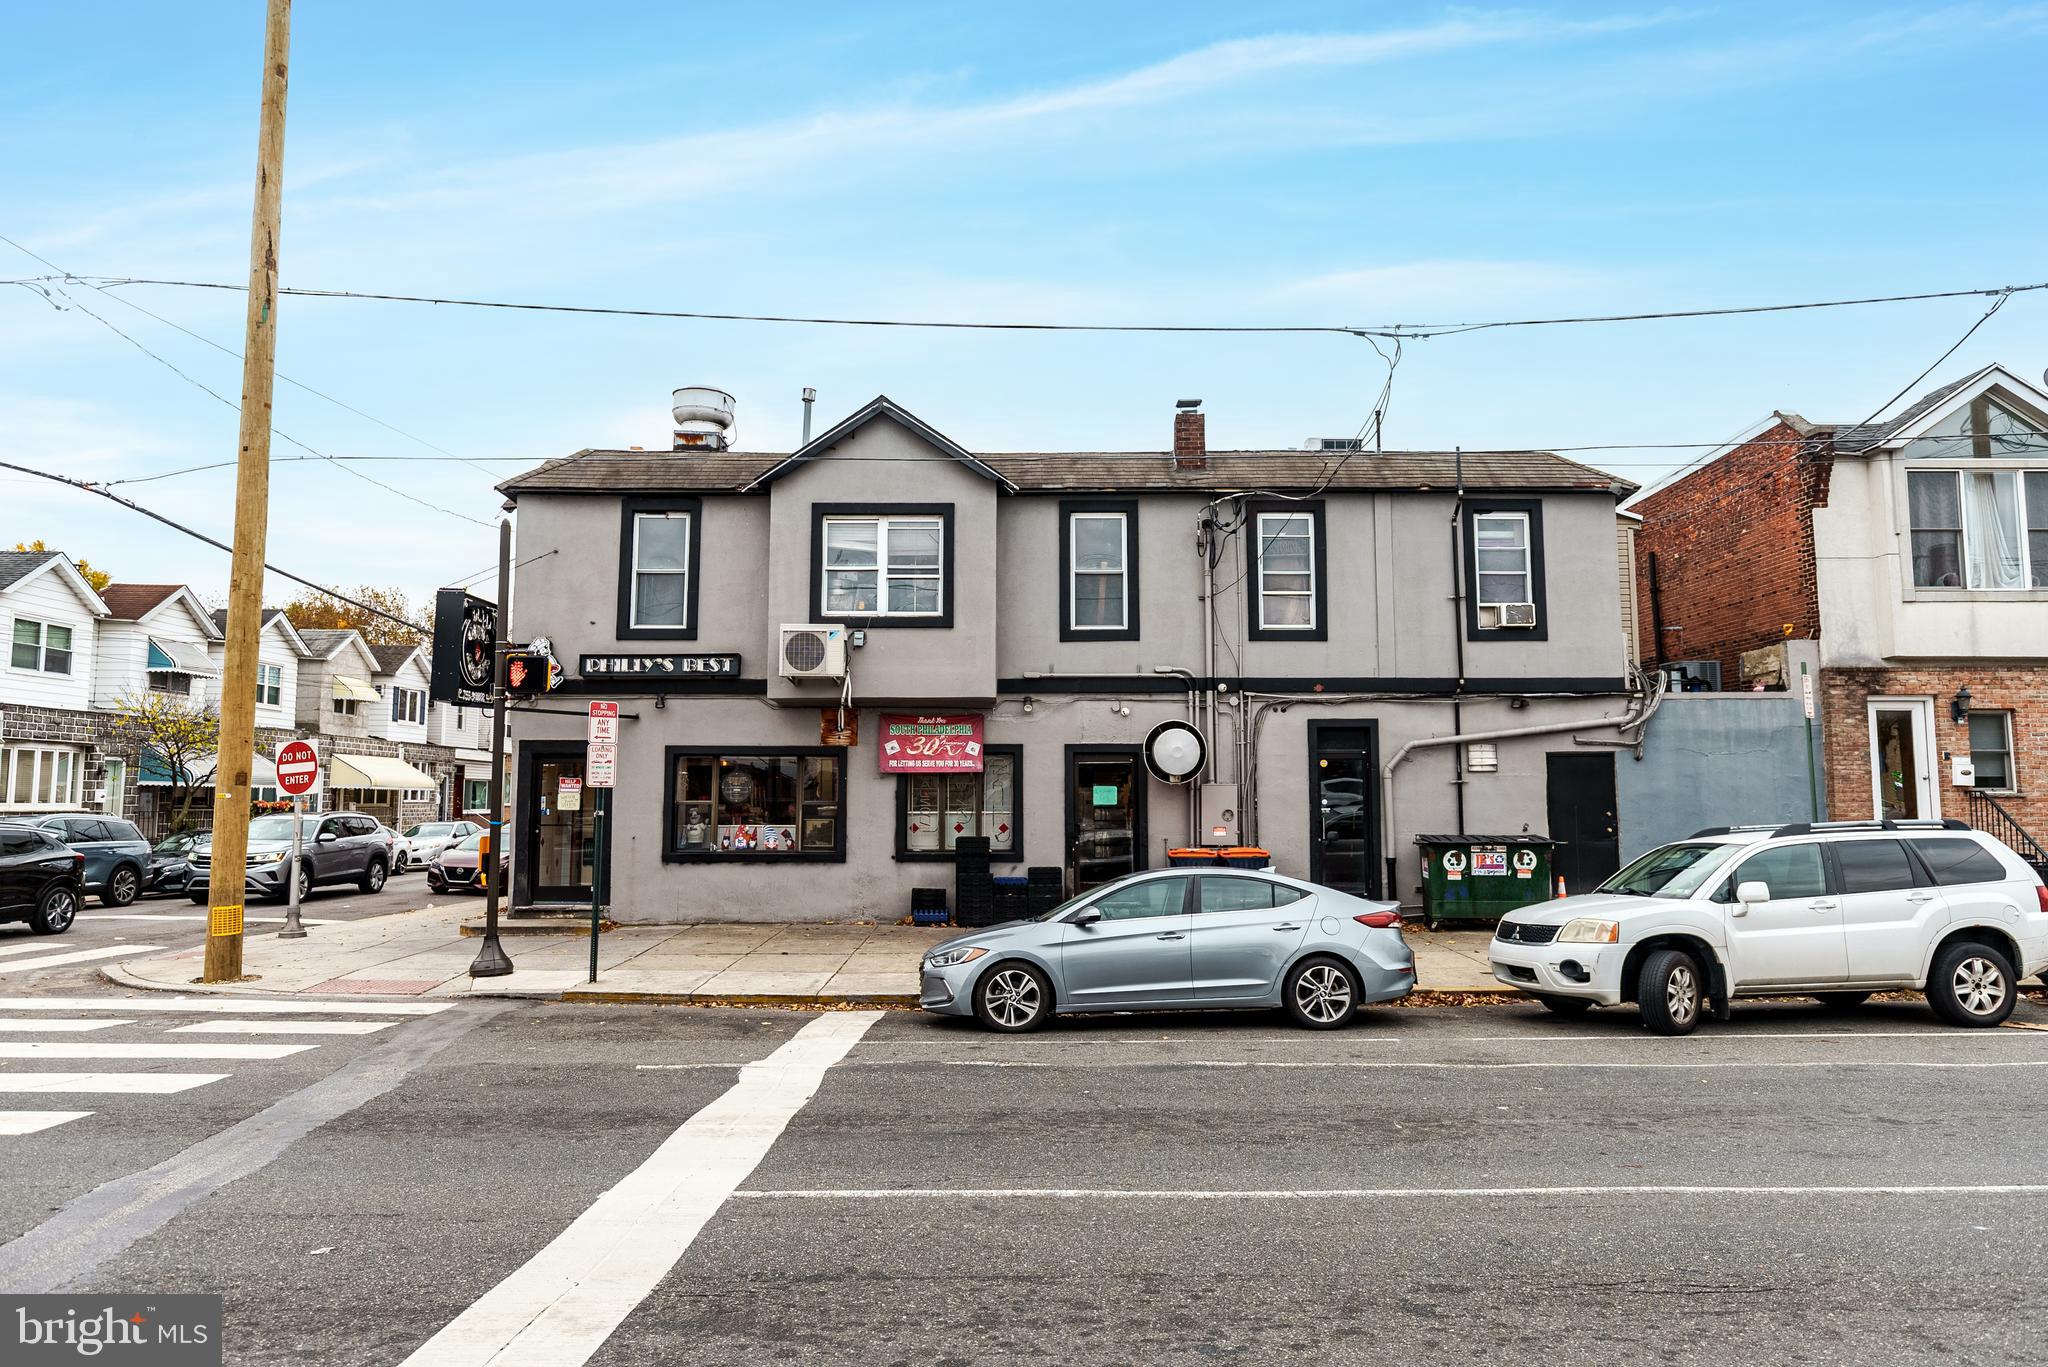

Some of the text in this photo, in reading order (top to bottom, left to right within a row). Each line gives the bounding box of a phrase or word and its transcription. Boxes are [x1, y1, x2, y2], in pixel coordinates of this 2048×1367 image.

[586, 657, 733, 673] PHILLY'S BEST
[592, 709, 616, 717] STOPPING
[889, 724, 973, 735] SOUTH PHILADELPHIA
[282, 751, 311, 761] DO NOT
[285, 775, 309, 785] ENTER
